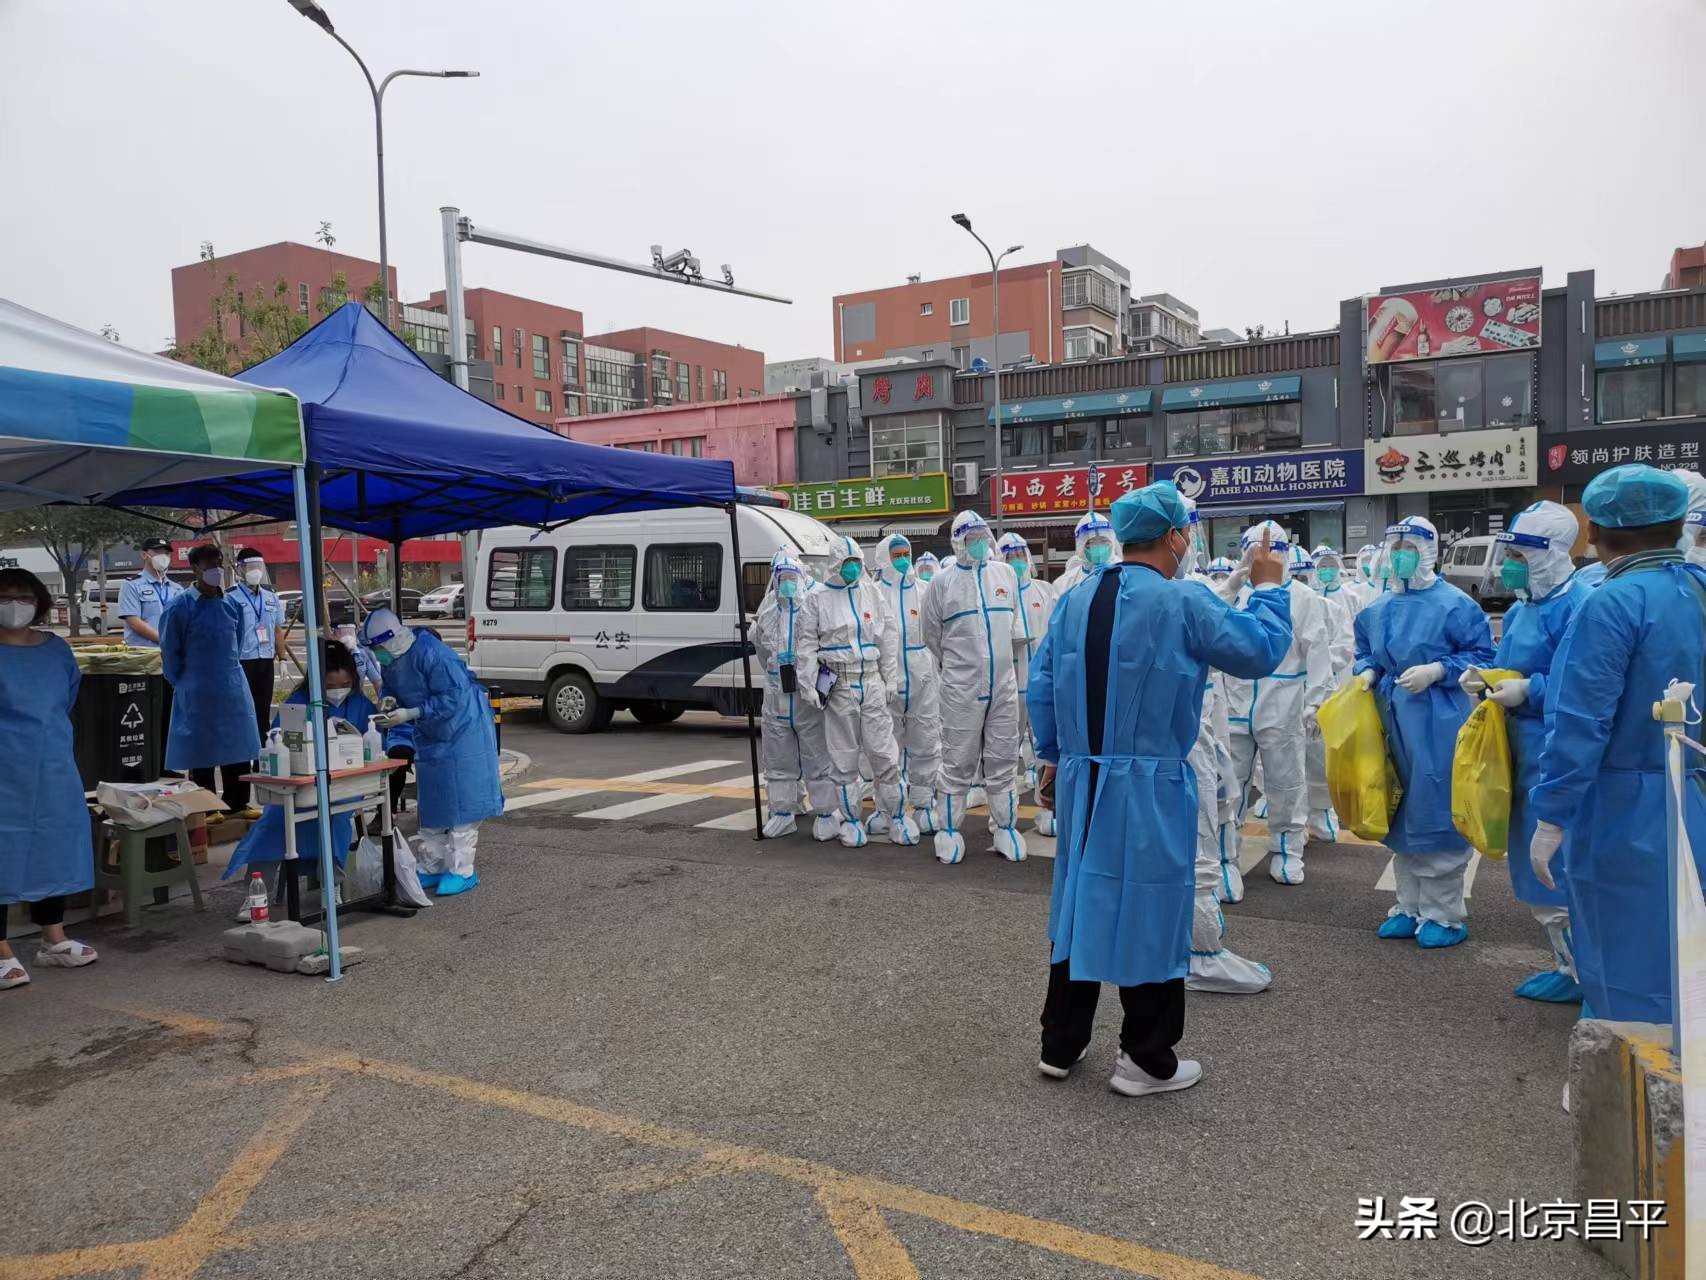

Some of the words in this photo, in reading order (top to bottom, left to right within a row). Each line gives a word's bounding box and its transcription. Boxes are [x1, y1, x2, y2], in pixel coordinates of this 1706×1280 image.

[1570, 442, 1699, 465] 领尚护肤造型
[1210, 458, 1346, 487] 嘉和动物医院
[792, 486, 885, 511] 佳百生鲜
[1210, 487, 1241, 497] JIAHE
[1243, 484, 1285, 494] ANIMAL
[1289, 479, 1347, 491] HOSPITAL
[595, 631, 630, 650] 公安
